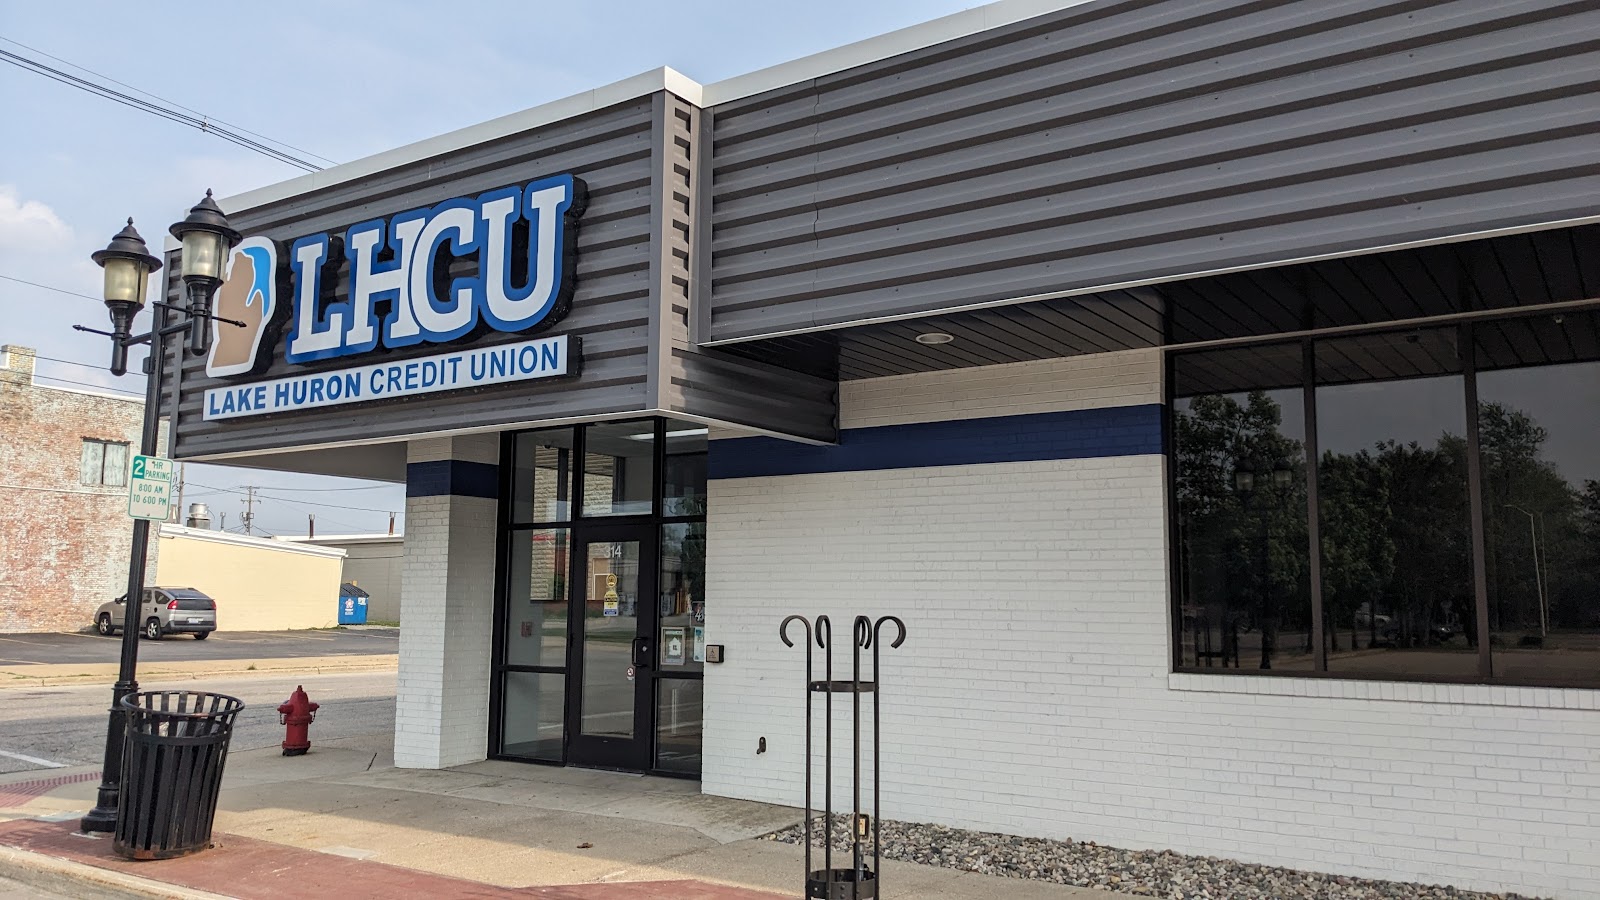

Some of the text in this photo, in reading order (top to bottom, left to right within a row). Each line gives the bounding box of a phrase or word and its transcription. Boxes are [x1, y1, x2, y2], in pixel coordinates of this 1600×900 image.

[291, 184, 566, 355] LHCU
[209, 341, 559, 416] LAKE HURON CREDIT UNION
[133, 459, 164, 476] 2 HR
[145, 470, 170, 480] PARKING
[154, 486, 163, 494] AM
[133, 494, 140, 503] TO
[158, 497, 167, 505] PM
[604, 545, 622, 558] 314
